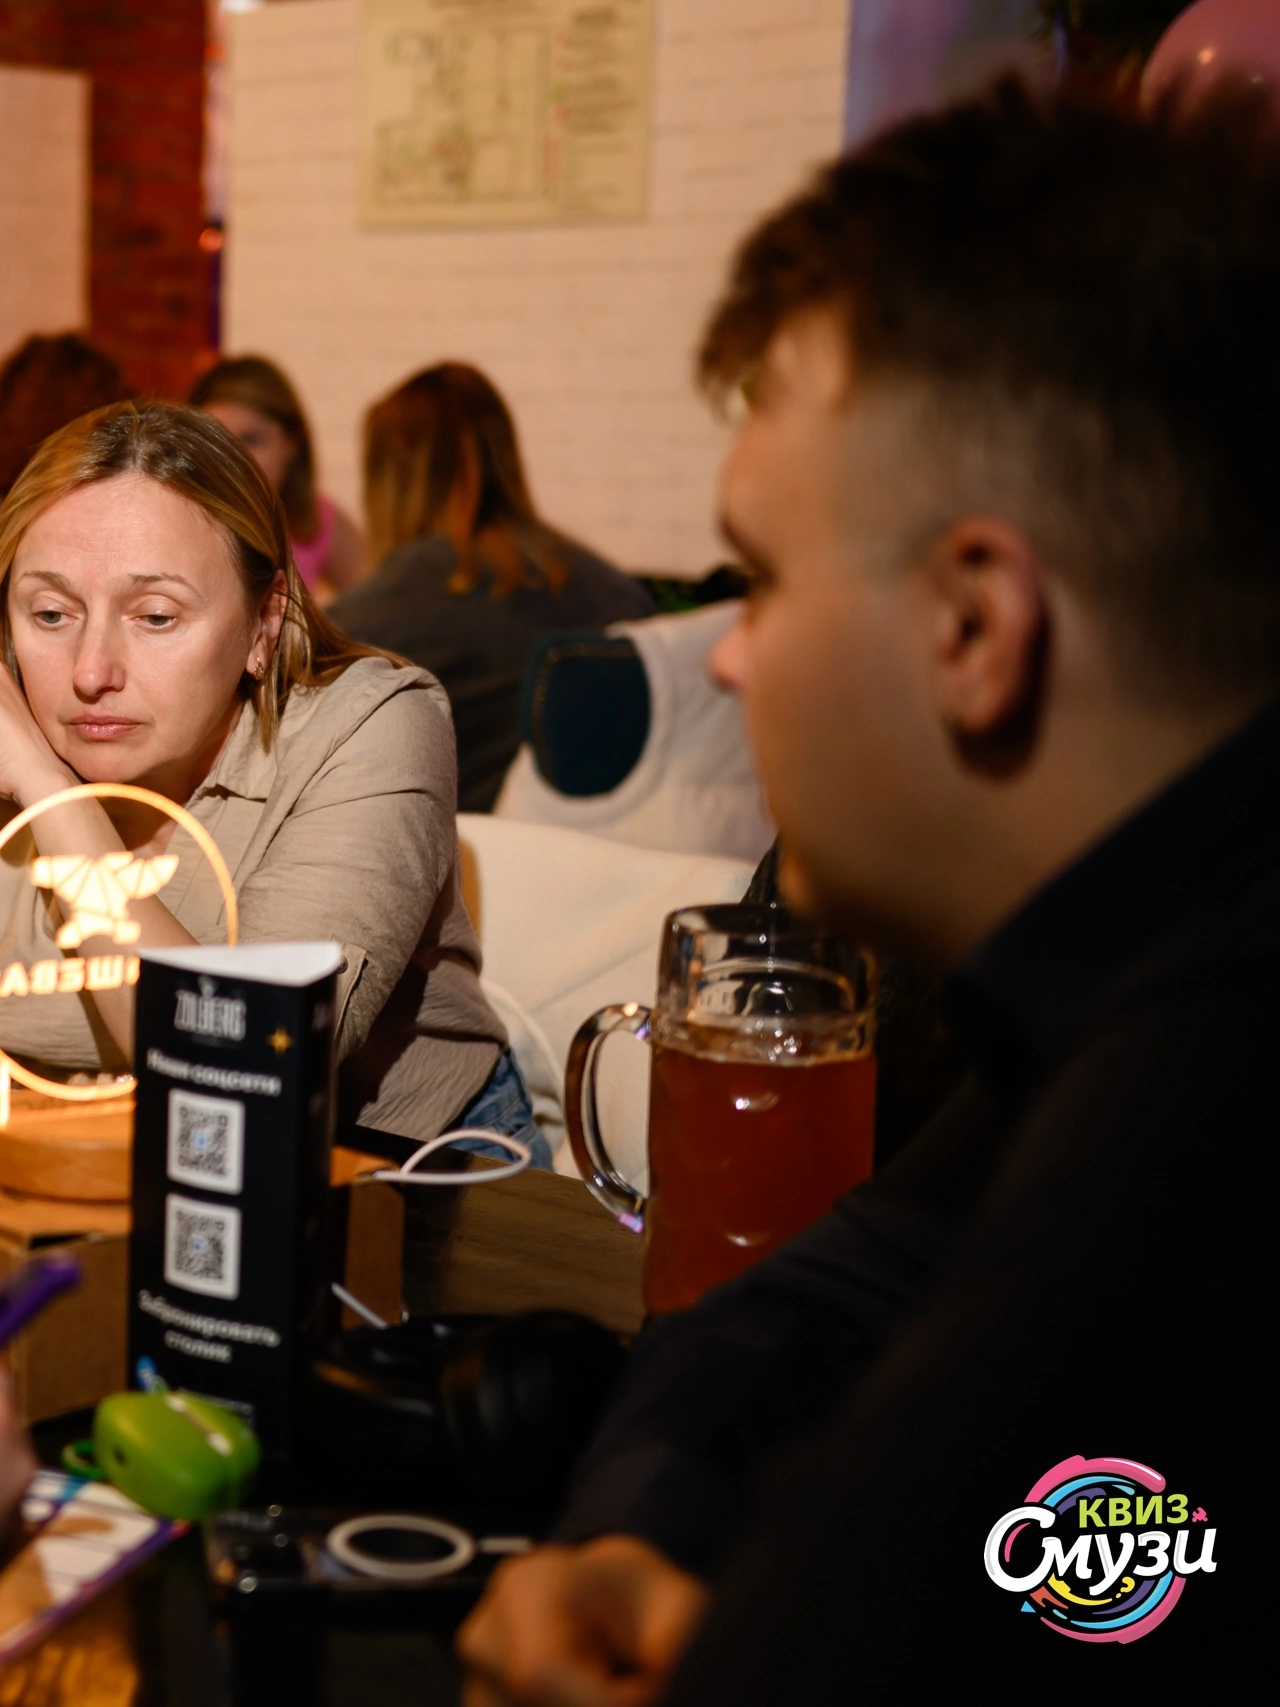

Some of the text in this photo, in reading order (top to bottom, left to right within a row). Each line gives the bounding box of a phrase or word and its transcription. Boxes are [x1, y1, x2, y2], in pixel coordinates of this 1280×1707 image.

[191, 1064, 282, 1097] соцсети
[138, 1289, 281, 1348] Забронировать
[164, 1330, 232, 1364] столик
